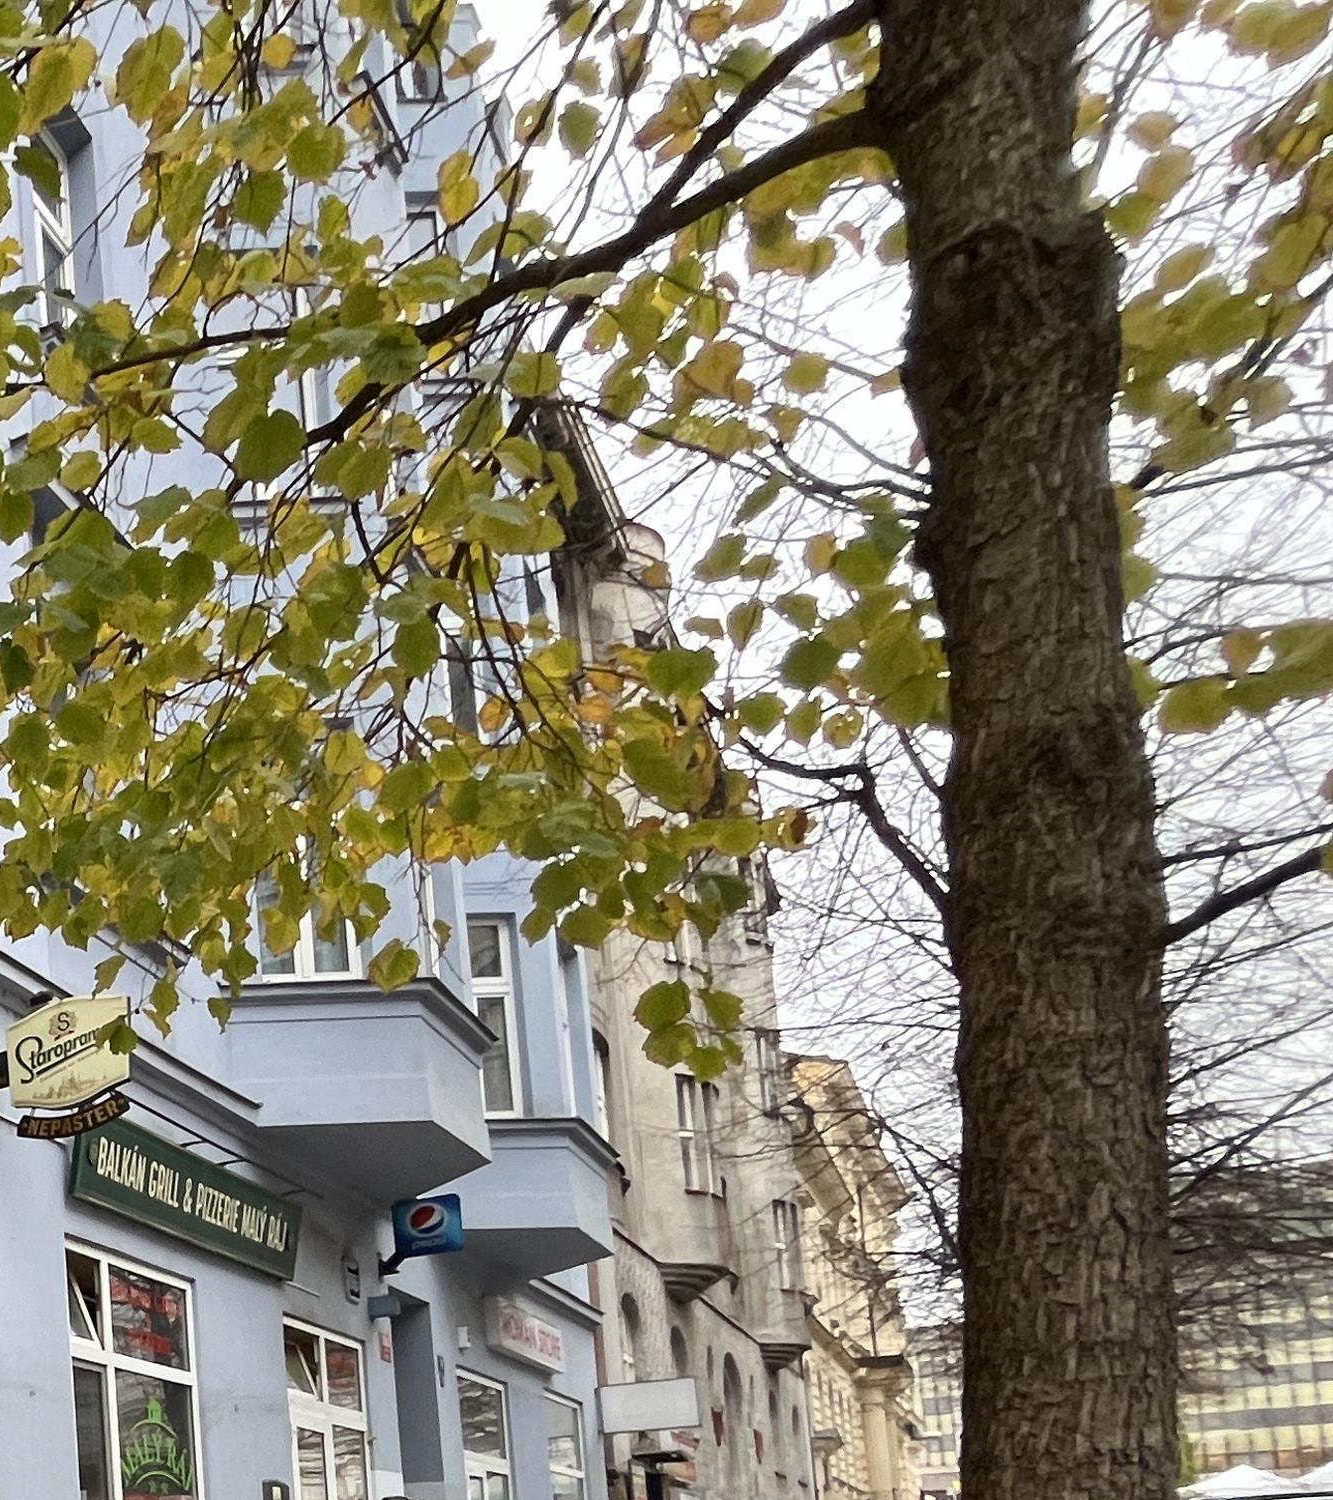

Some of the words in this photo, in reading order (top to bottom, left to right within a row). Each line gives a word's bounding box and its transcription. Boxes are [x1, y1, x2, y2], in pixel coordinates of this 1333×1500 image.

[97, 1136, 147, 1193] BALKÁN
[148, 1161, 179, 1208] GRILL
[183, 1178, 193, 1213] &
[196, 1182, 240, 1233] PIZZERIE
[241, 1205, 267, 1243] MALÝ
